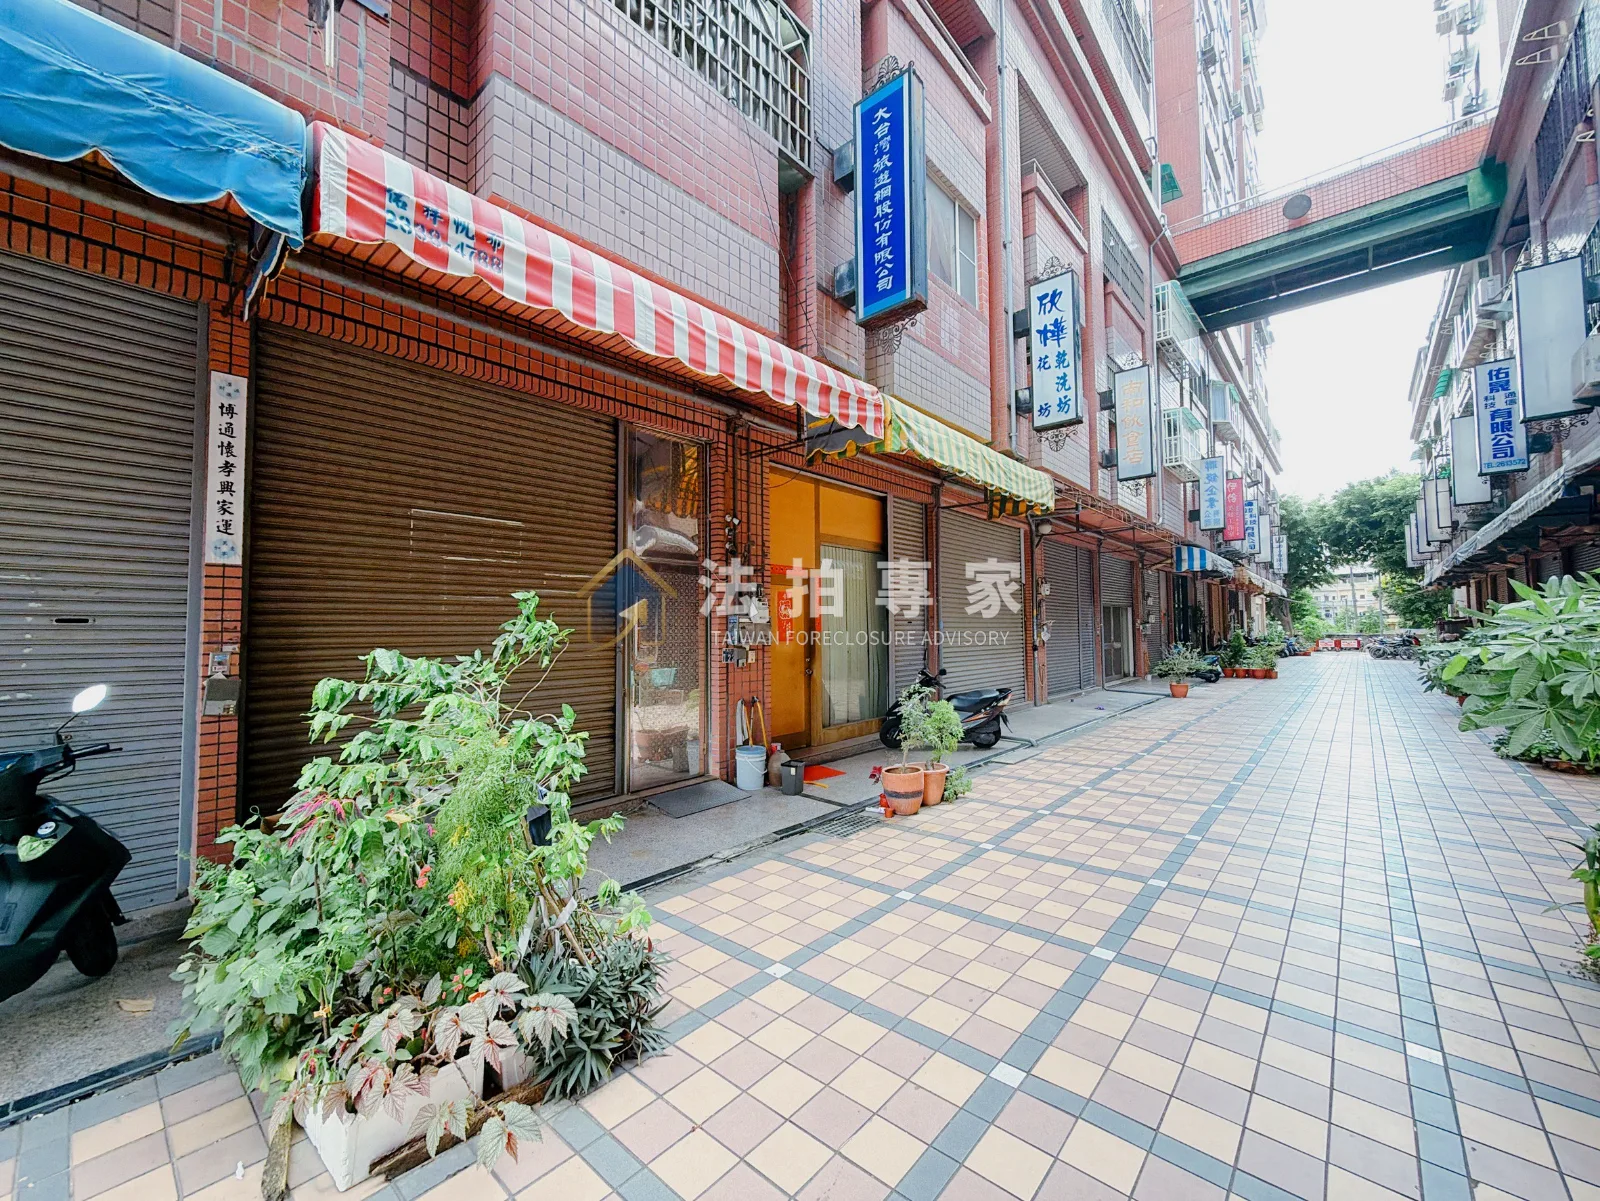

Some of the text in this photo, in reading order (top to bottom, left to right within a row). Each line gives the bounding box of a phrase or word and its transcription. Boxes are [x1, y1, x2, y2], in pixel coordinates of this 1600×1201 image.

[872, 106, 894, 293] 大台灣旅遊網股份有限公司
[1035, 288, 1068, 348] 欣樺
[1054, 349, 1072, 415] 乾洗坊
[1490, 407, 1514, 459] 有限公司
[216, 402, 238, 536] 博通懷孝興家運
